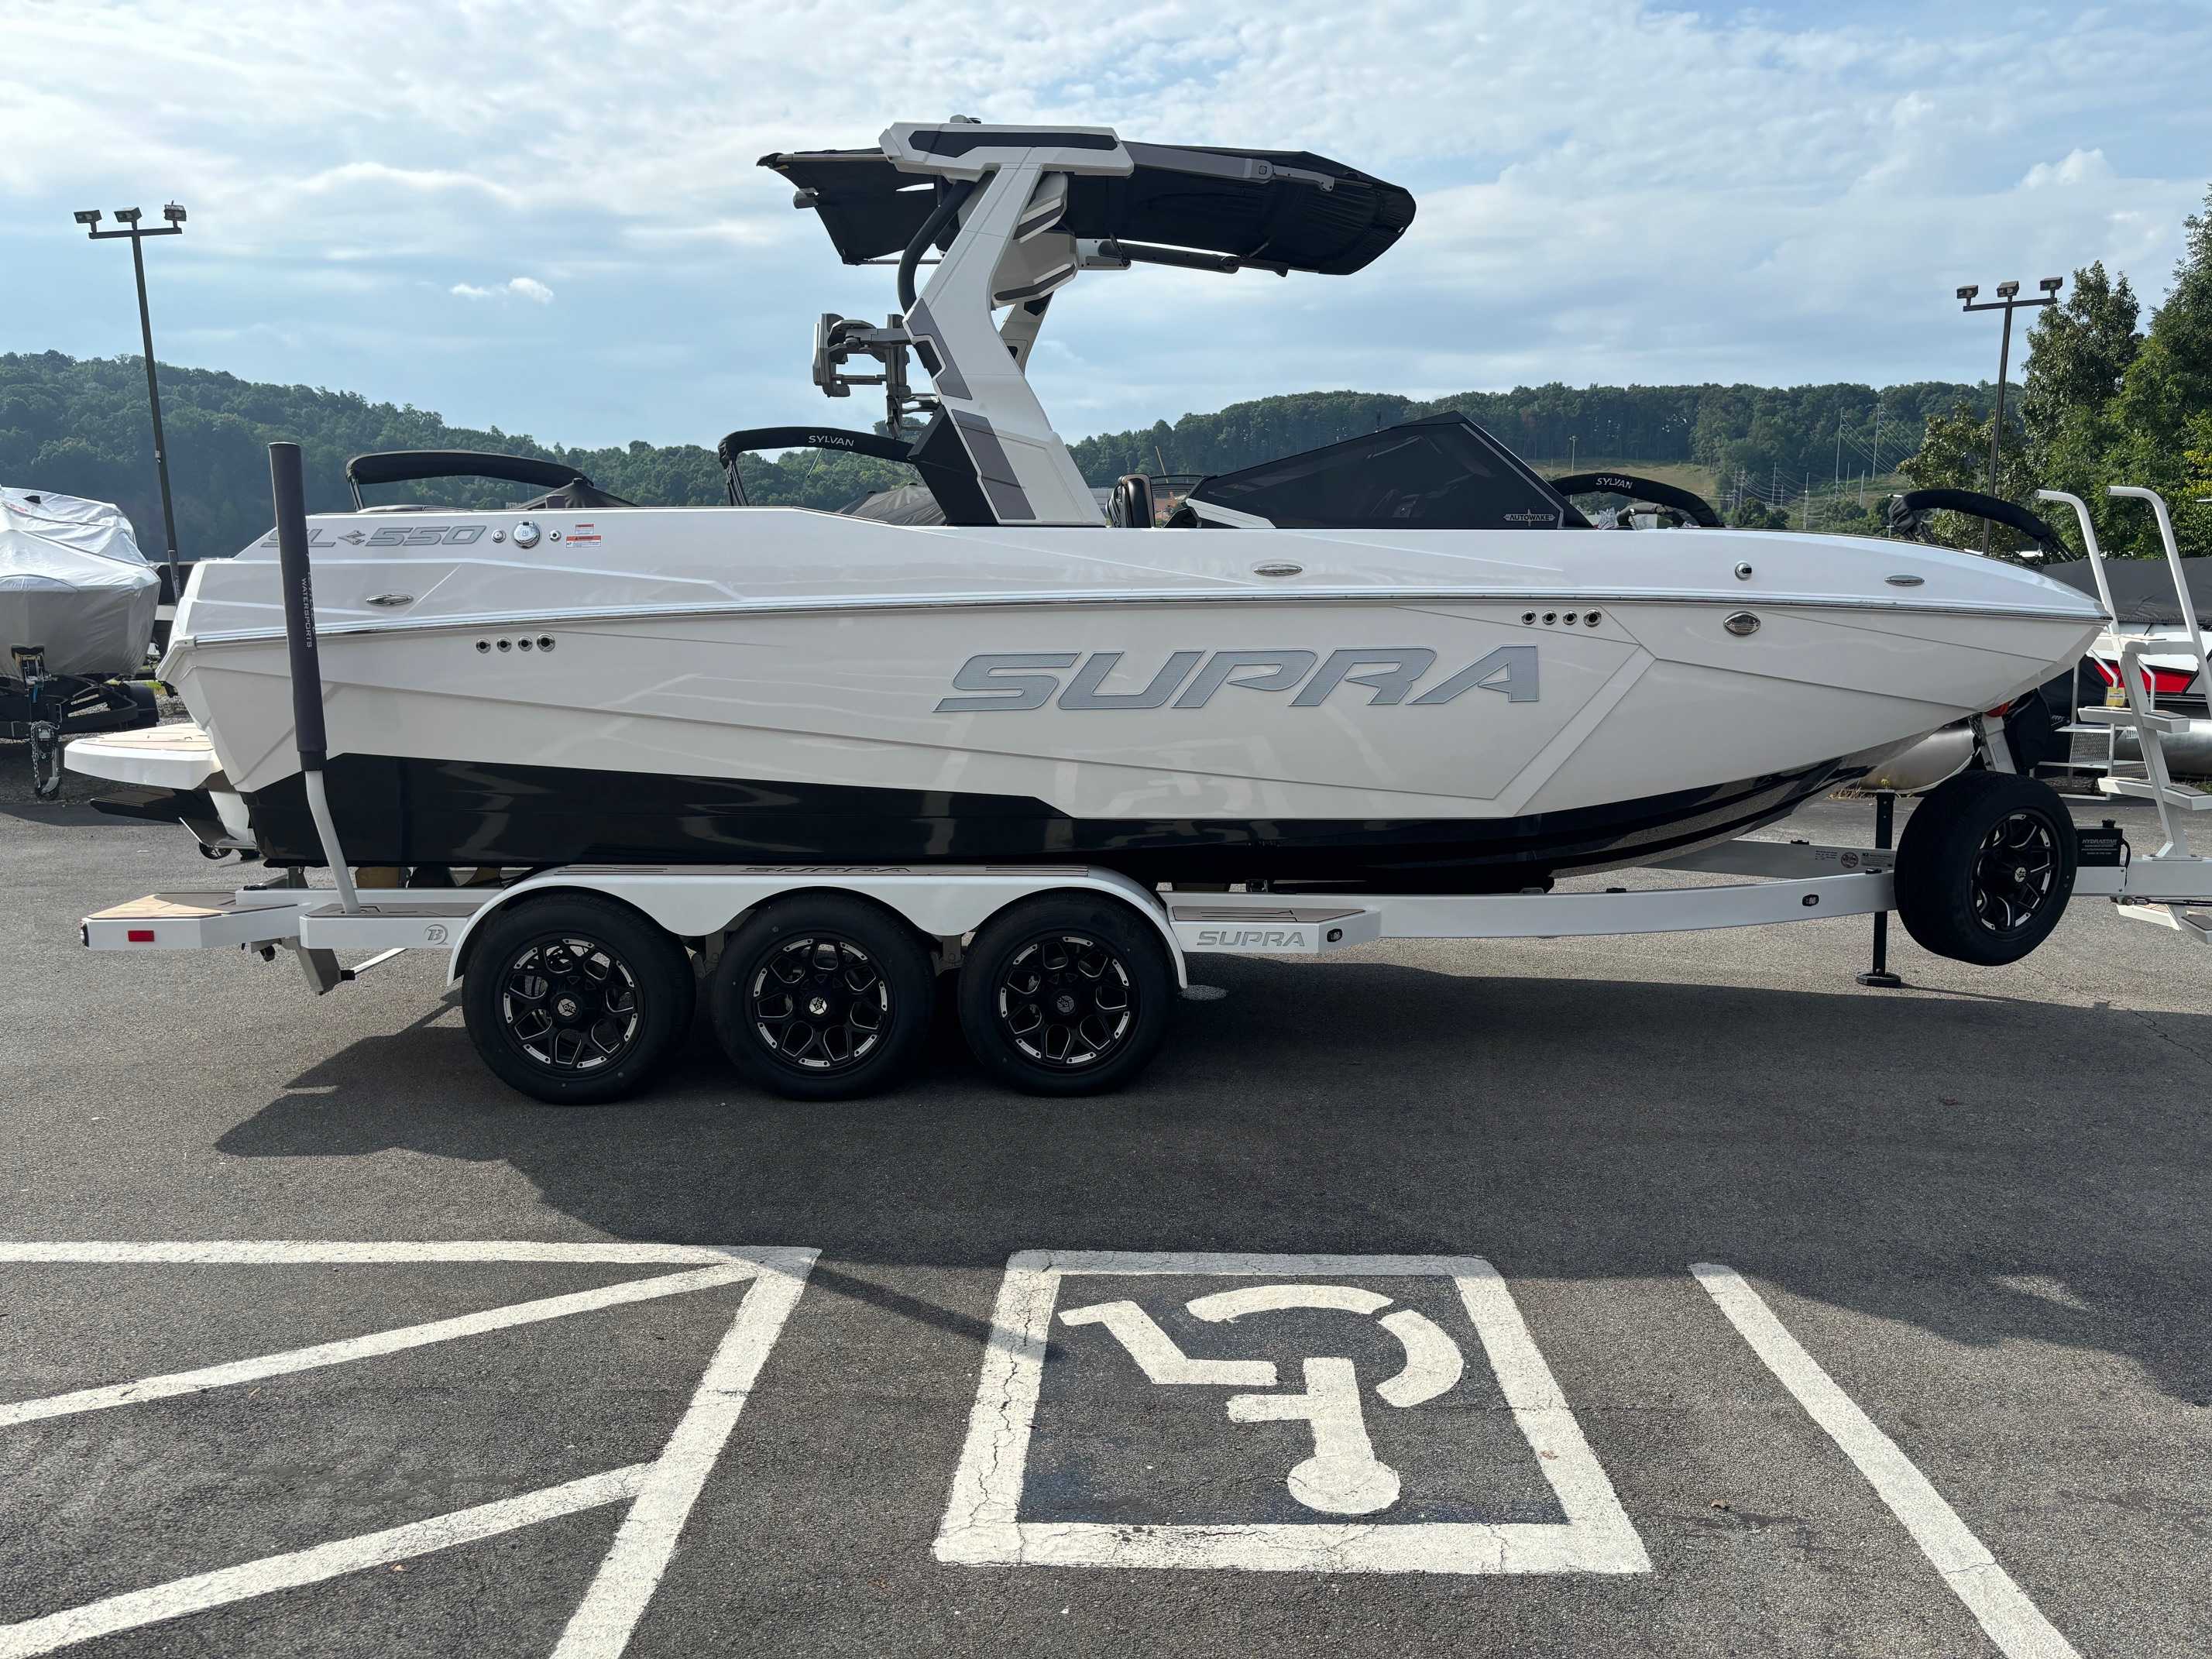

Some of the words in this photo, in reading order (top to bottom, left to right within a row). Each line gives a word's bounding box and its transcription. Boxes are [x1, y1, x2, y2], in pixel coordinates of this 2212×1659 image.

[808, 435, 854, 447] SYLVAN
[1595, 477, 1633, 489] SYLVAN
[365, 525, 487, 547] 550
[301, 577, 313, 647] WATERSPORTS
[931, 644, 1540, 713] SUPRA
[1196, 931, 1306, 947] SUPRA
